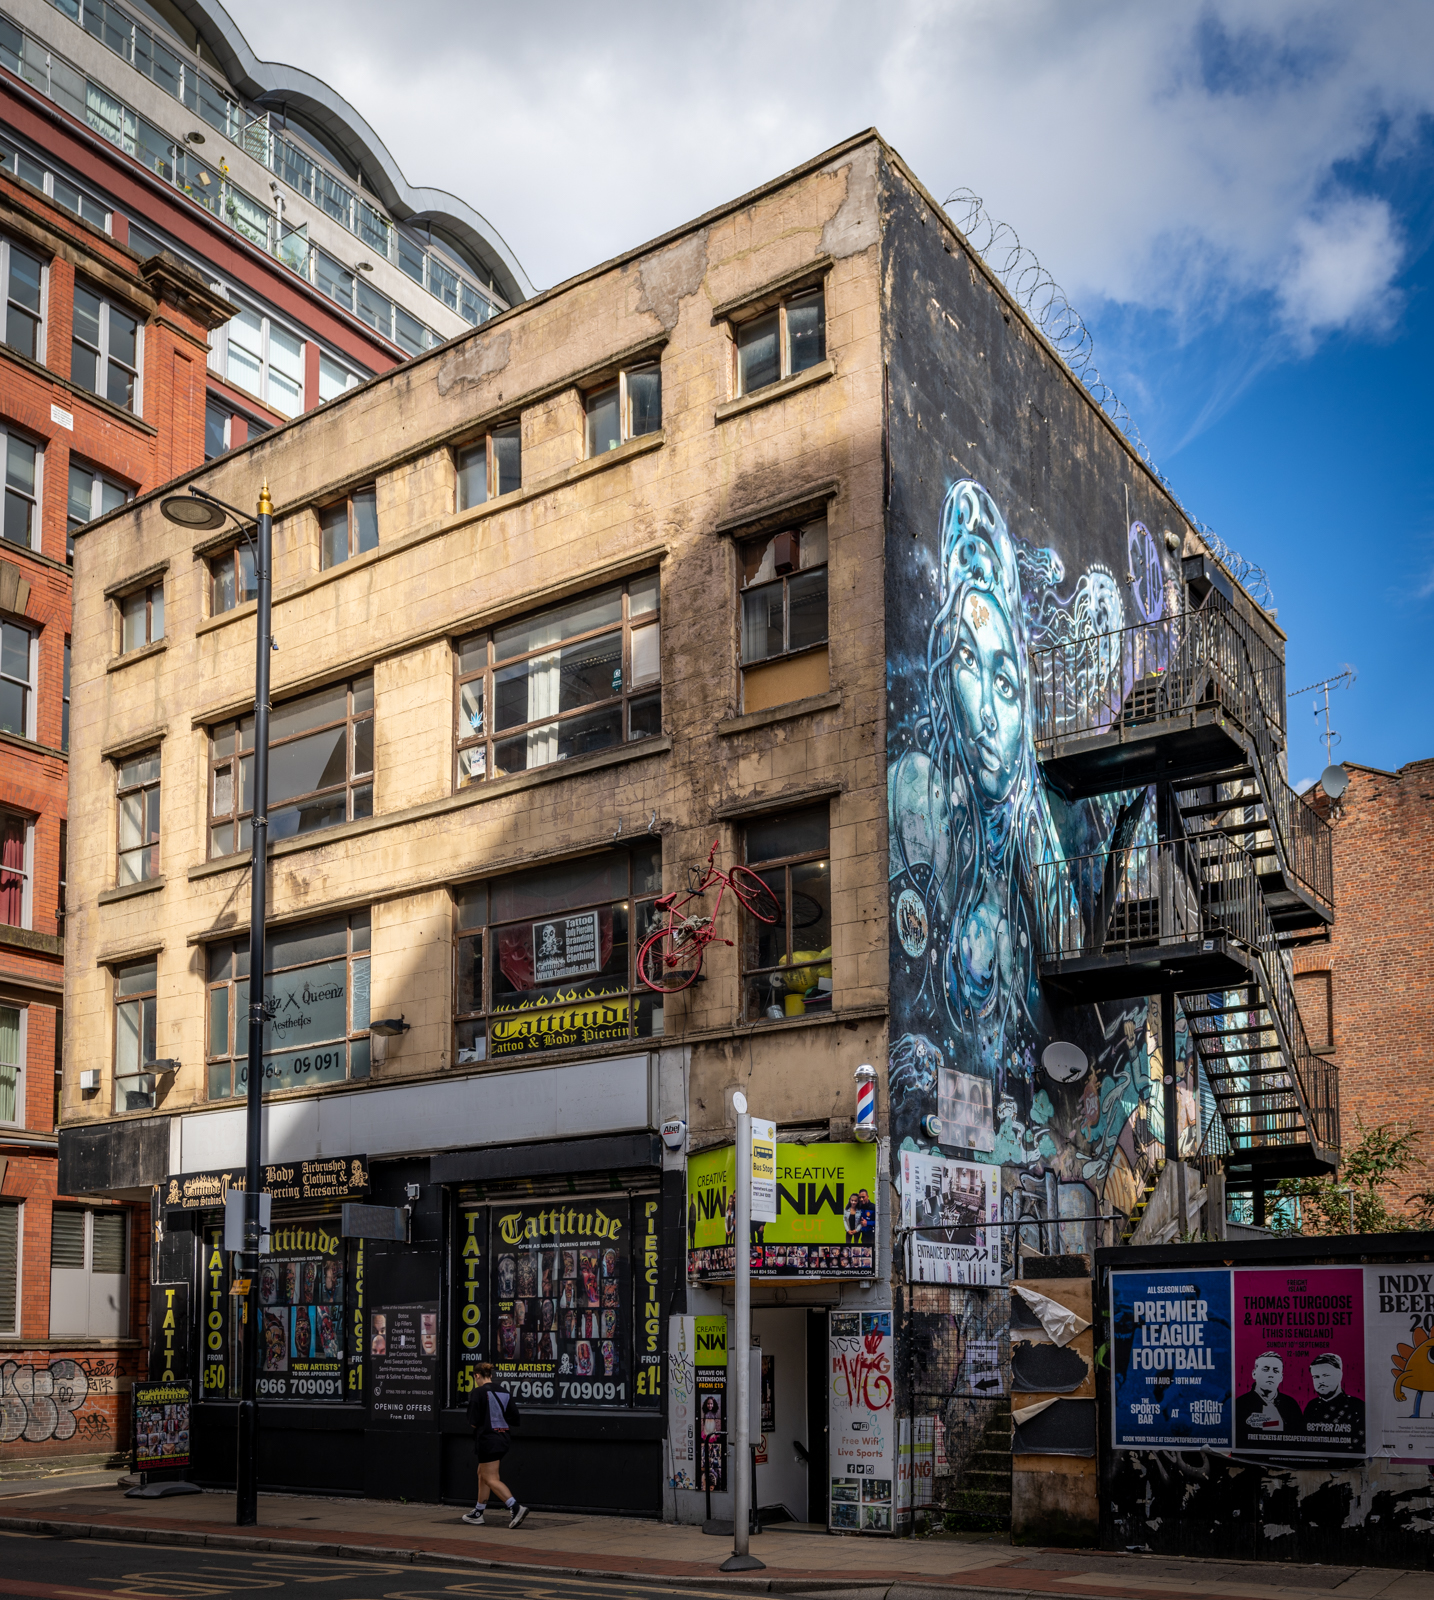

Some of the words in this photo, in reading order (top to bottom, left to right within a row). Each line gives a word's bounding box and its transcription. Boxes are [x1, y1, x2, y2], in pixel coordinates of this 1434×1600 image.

[565, 916, 594, 928] Tattoo
[566, 928, 577, 937] Body
[577, 925, 594, 935] Piercing
[566, 934, 595, 945] Branding
[566, 942, 596, 954] Removals
[567, 951, 595, 963] Clothing
[302, 987, 344, 1005] Queenz
[271, 1013, 312, 1032] Aesthetics
[491, 1005, 638, 1041] Tattitude
[528, 1034, 540, 1048] &
[543, 1027, 577, 1048] Body
[315, 1052, 339, 1071] 091
[663, 1124, 680, 1133] Abel
[302, 1160, 346, 1174] Airbrushed
[753, 1162, 762, 1171] Bus
[762, 1164, 774, 1175] Stop
[776, 1167, 845, 1179] CREATIVE
[265, 1166, 295, 1185] Body
[302, 1173, 338, 1186] Clothing
[339, 1172, 348, 1181] &
[697, 1170, 727, 1187] CREATIVE
[182, 1183, 222, 1198] Tattitude
[182, 1197, 200, 1208] Tattoo
[200, 1196, 222, 1206] Studios
[303, 1184, 349, 1198] Accesories
[697, 1186, 727, 1221] NW
[776, 1183, 845, 1215] NW
[498, 1206, 622, 1245] Tattitude
[792, 1219, 825, 1231] CUT
[917, 1244, 943, 1260] ENTRANCE
[943, 1248, 951, 1261] UP
[951, 1248, 970, 1262] STAIRS
[462, 1212, 481, 1349] TATTOO
[645, 1201, 660, 1352] PIERCINGS
[1378, 1274, 1433, 1294] INDY
[208, 1230, 223, 1350] TATTOO
[1147, 1286, 1157, 1294] ALL
[1157, 1286, 1179, 1294] SEASON
[1180, 1285, 1197, 1293] LONG.
[1244, 1296, 1290, 1310] THOMAS
[1293, 1295, 1352, 1309] TURGOOSE
[1133, 1300, 1208, 1323] PREMIER
[1244, 1313, 1252, 1325] &
[1255, 1313, 1284, 1325] ANDY
[1287, 1312, 1315, 1325] ELLIS
[1318, 1312, 1330, 1326] DJ
[1332, 1312, 1353, 1325] SET
[1142, 1324, 1204, 1346] LEAGUE
[1285, 1329, 1292, 1338] IS
[1294, 1328, 1333, 1339] ENGLAND]
[697, 1334, 726, 1350] NW
[461, 1353, 482, 1361] FROM
[1132, 1348, 1216, 1370] FOOTBALL
[204, 1364, 226, 1389] £50
[290, 1379, 343, 1395] 709091
[559, 1382, 626, 1400] 709091
[374, 1403, 404, 1411] OPENING
[406, 1403, 432, 1411] OFFERS
[1130, 1403, 1160, 1415] SPORTS
[1171, 1409, 1180, 1418] AT
[1189, 1400, 1223, 1413] FREIGHT
[1138, 1414, 1153, 1424] BAR
[1191, 1413, 1221, 1425] ISLAND
[675, 1405, 687, 1461] HANG
[1307, 1422, 1334, 1432] BETTER
[1334, 1423, 1351, 1433] DAYS
[842, 1437, 859, 1445] Free
[861, 1437, 879, 1445] Wifi
[1283, 1435, 1351, 1444] ESCAPETOFREIGHTISLAND.COM
[838, 1448, 854, 1456] Live
[857, 1449, 883, 1459] Sports
